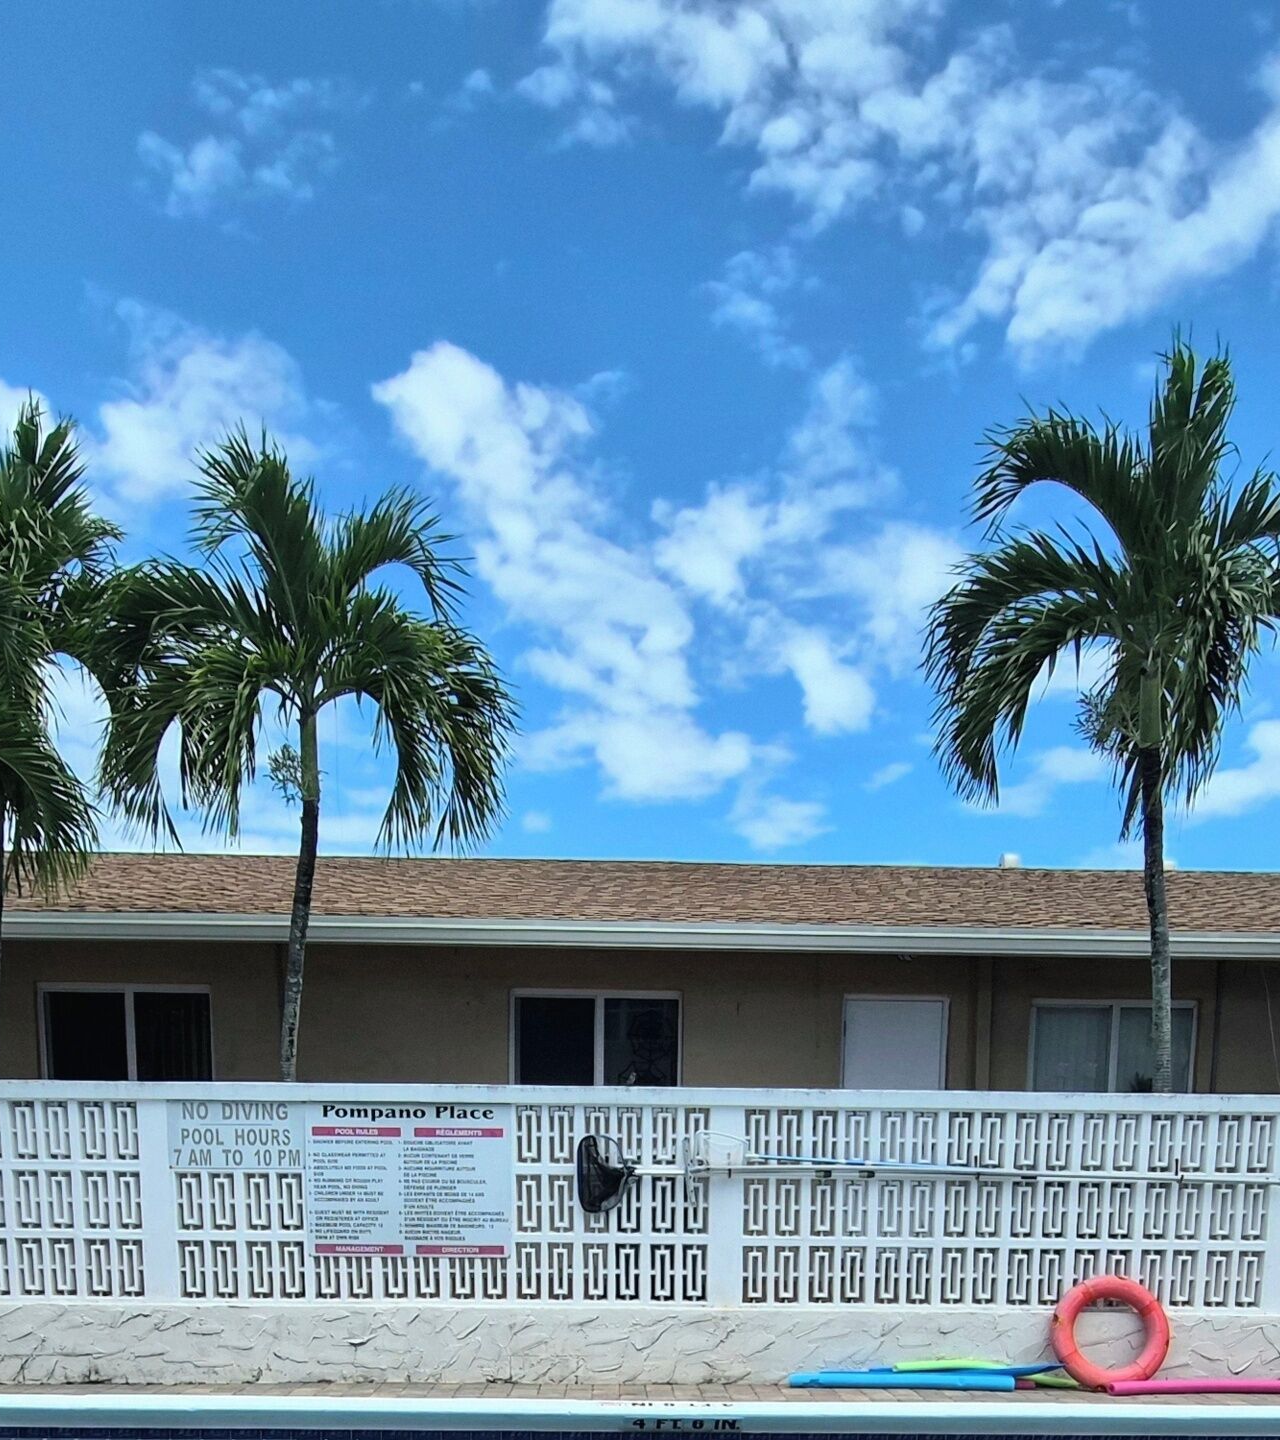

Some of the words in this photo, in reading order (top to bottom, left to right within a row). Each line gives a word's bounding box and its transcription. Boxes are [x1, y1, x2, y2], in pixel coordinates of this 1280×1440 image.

[182, 1102, 208, 1120] NO
[221, 1102, 288, 1121] DIVING
[322, 1104, 426, 1122] Pompano
[435, 1105, 494, 1120] Place
[181, 1128, 224, 1145] POOL
[235, 1128, 291, 1146] HOURS
[174, 1149, 182, 1166] 7
[188, 1149, 212, 1166] AM
[222, 1149, 243, 1166] TO
[254, 1149, 272, 1167] 10
[278, 1149, 301, 1167] PM
[632, 1418, 646, 1430] 4
